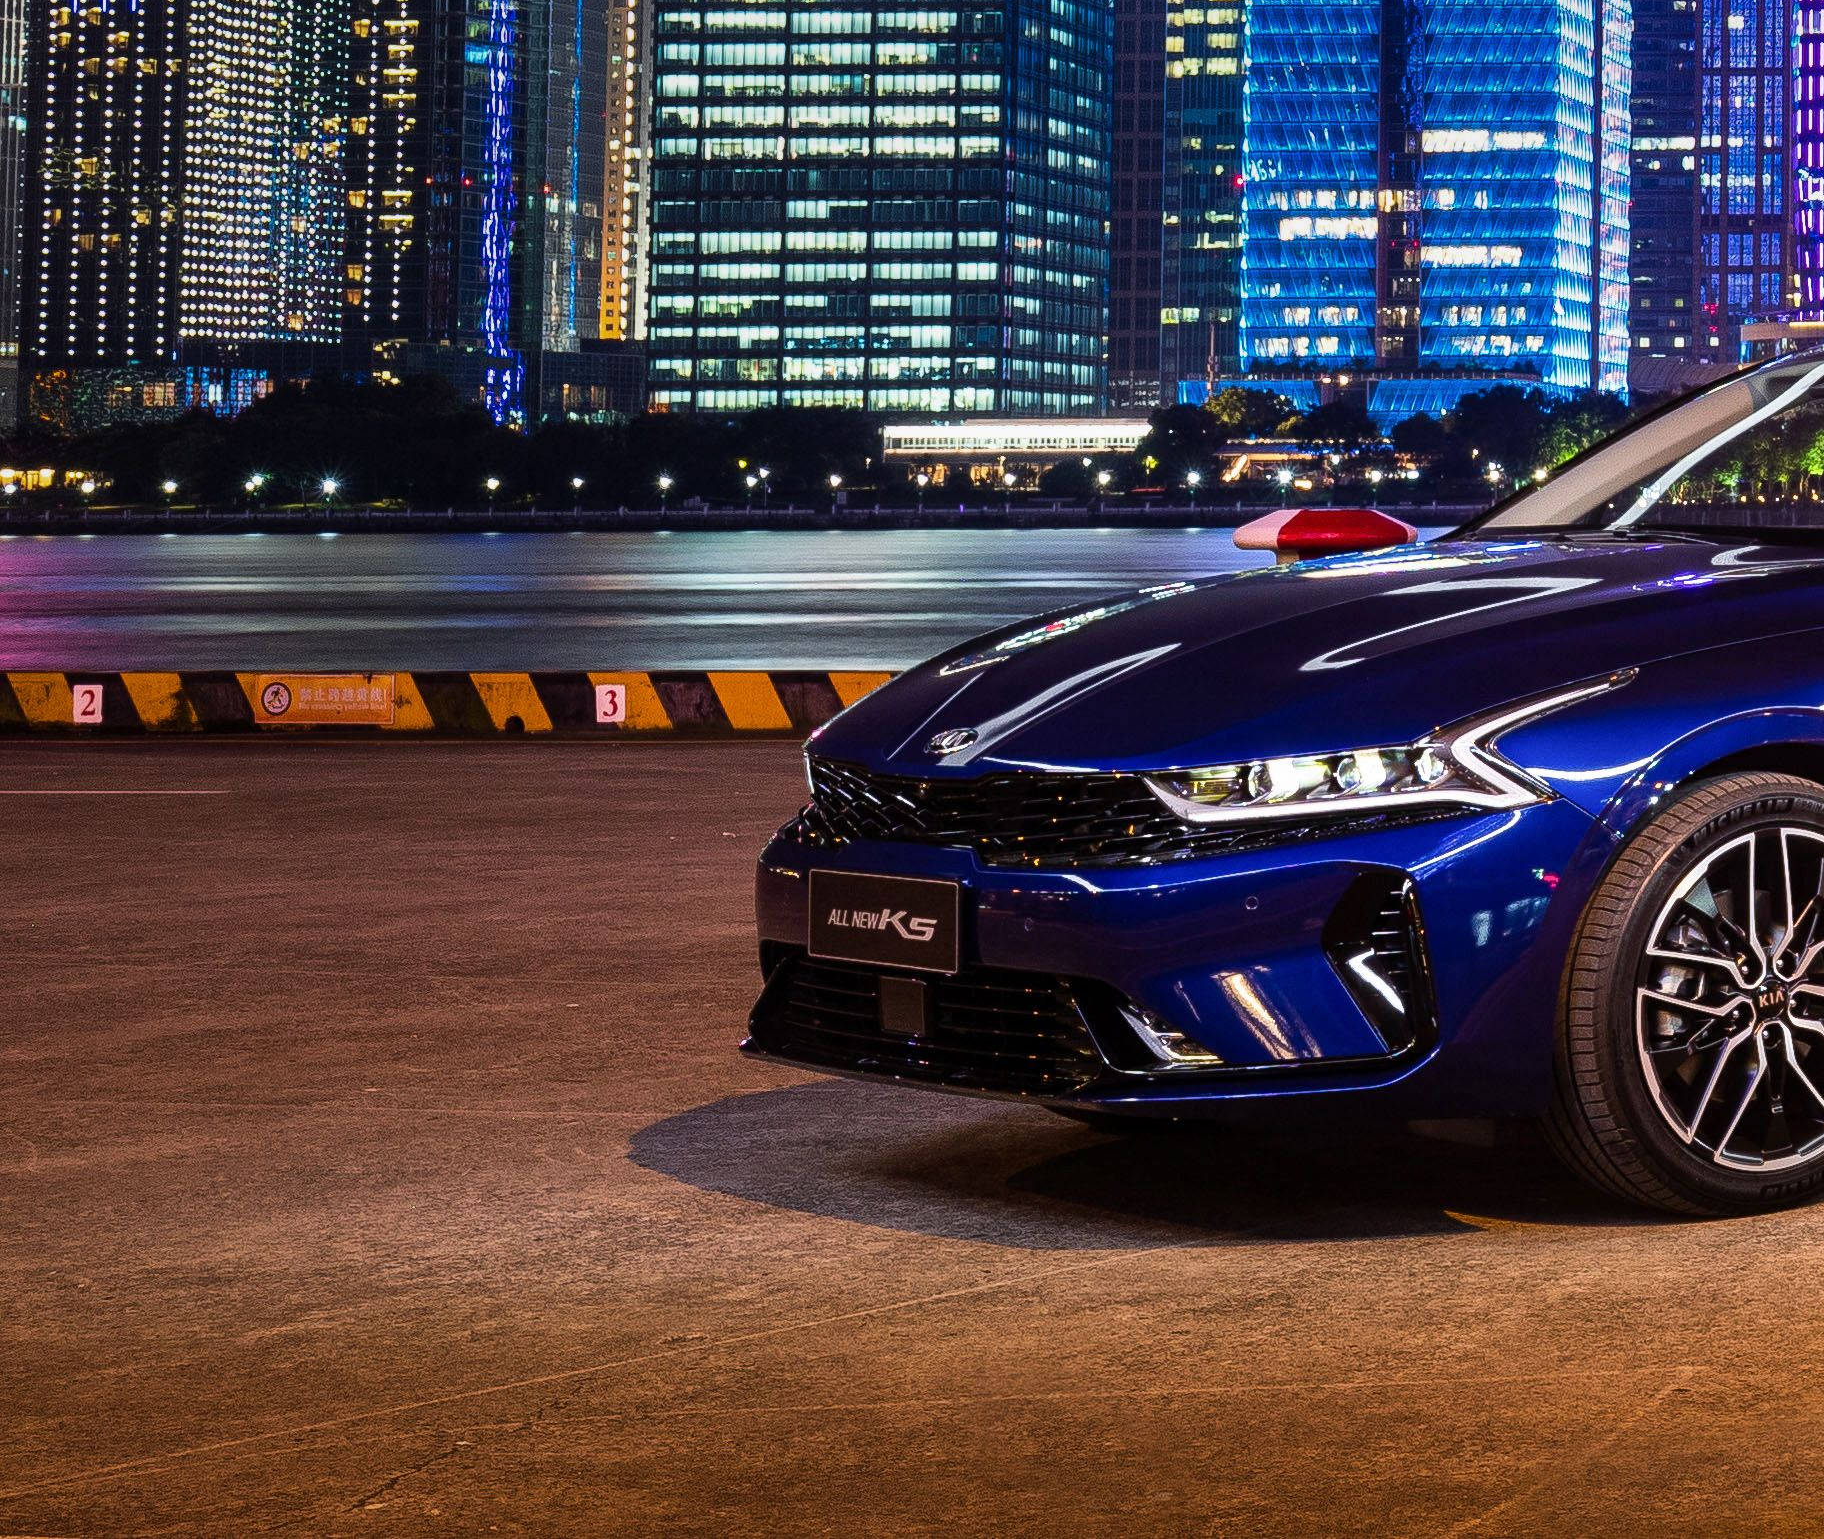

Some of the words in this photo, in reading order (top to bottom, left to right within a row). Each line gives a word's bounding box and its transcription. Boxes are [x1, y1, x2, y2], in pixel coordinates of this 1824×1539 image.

[81, 690, 95, 716] 2
[603, 690, 618, 716] 3
[827, 908, 850, 927] ALL
[851, 911, 879, 930] NEW
[877, 908, 938, 941] K5
[1759, 990, 1784, 1008] KIA
